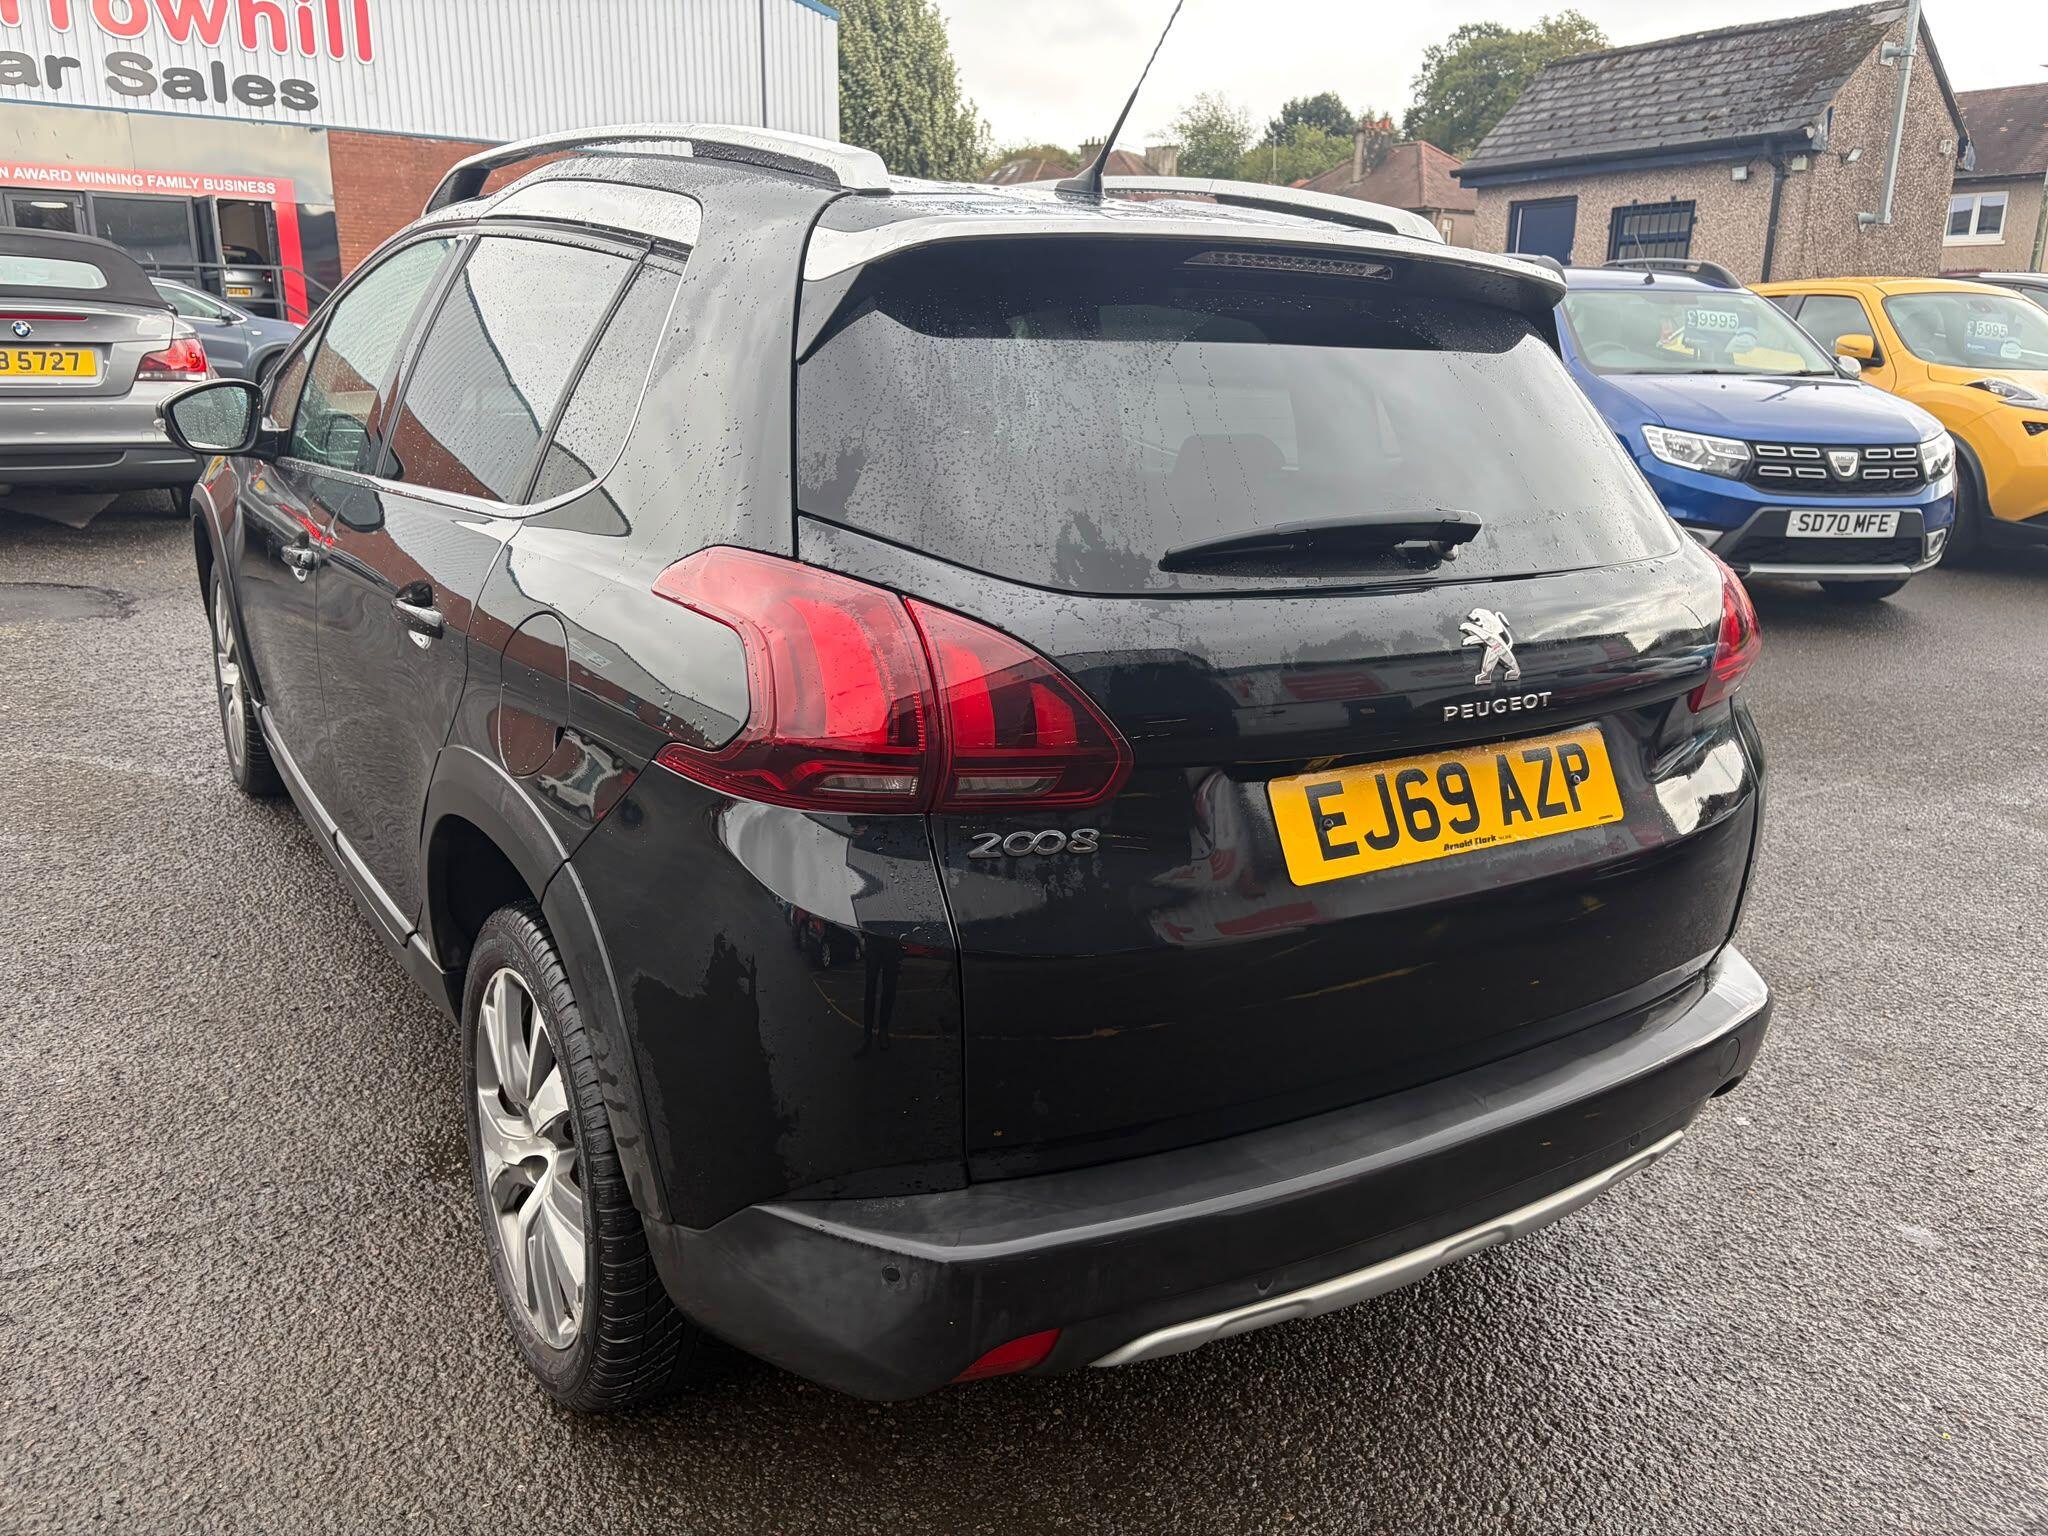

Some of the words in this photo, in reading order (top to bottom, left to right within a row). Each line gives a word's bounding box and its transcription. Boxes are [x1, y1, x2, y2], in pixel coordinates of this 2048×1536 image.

[105, 51, 319, 111] Sales
[13, 166, 72, 182] AWARD
[76, 170, 144, 187] WINNING
[146, 174, 199, 190] FAMILY
[203, 178, 277, 195] BUSINESS
[17, 351, 79, 371] 5727
[1797, 513, 1850, 533] SD70
[1853, 513, 1892, 533] MFE
[1443, 691, 1552, 722] PEUGEOT
[1304, 761, 1481, 862] EJ69
[1496, 742, 1590, 826] AZP
[967, 827, 1101, 860] 2008
[1443, 838, 1473, 852] Arnold
